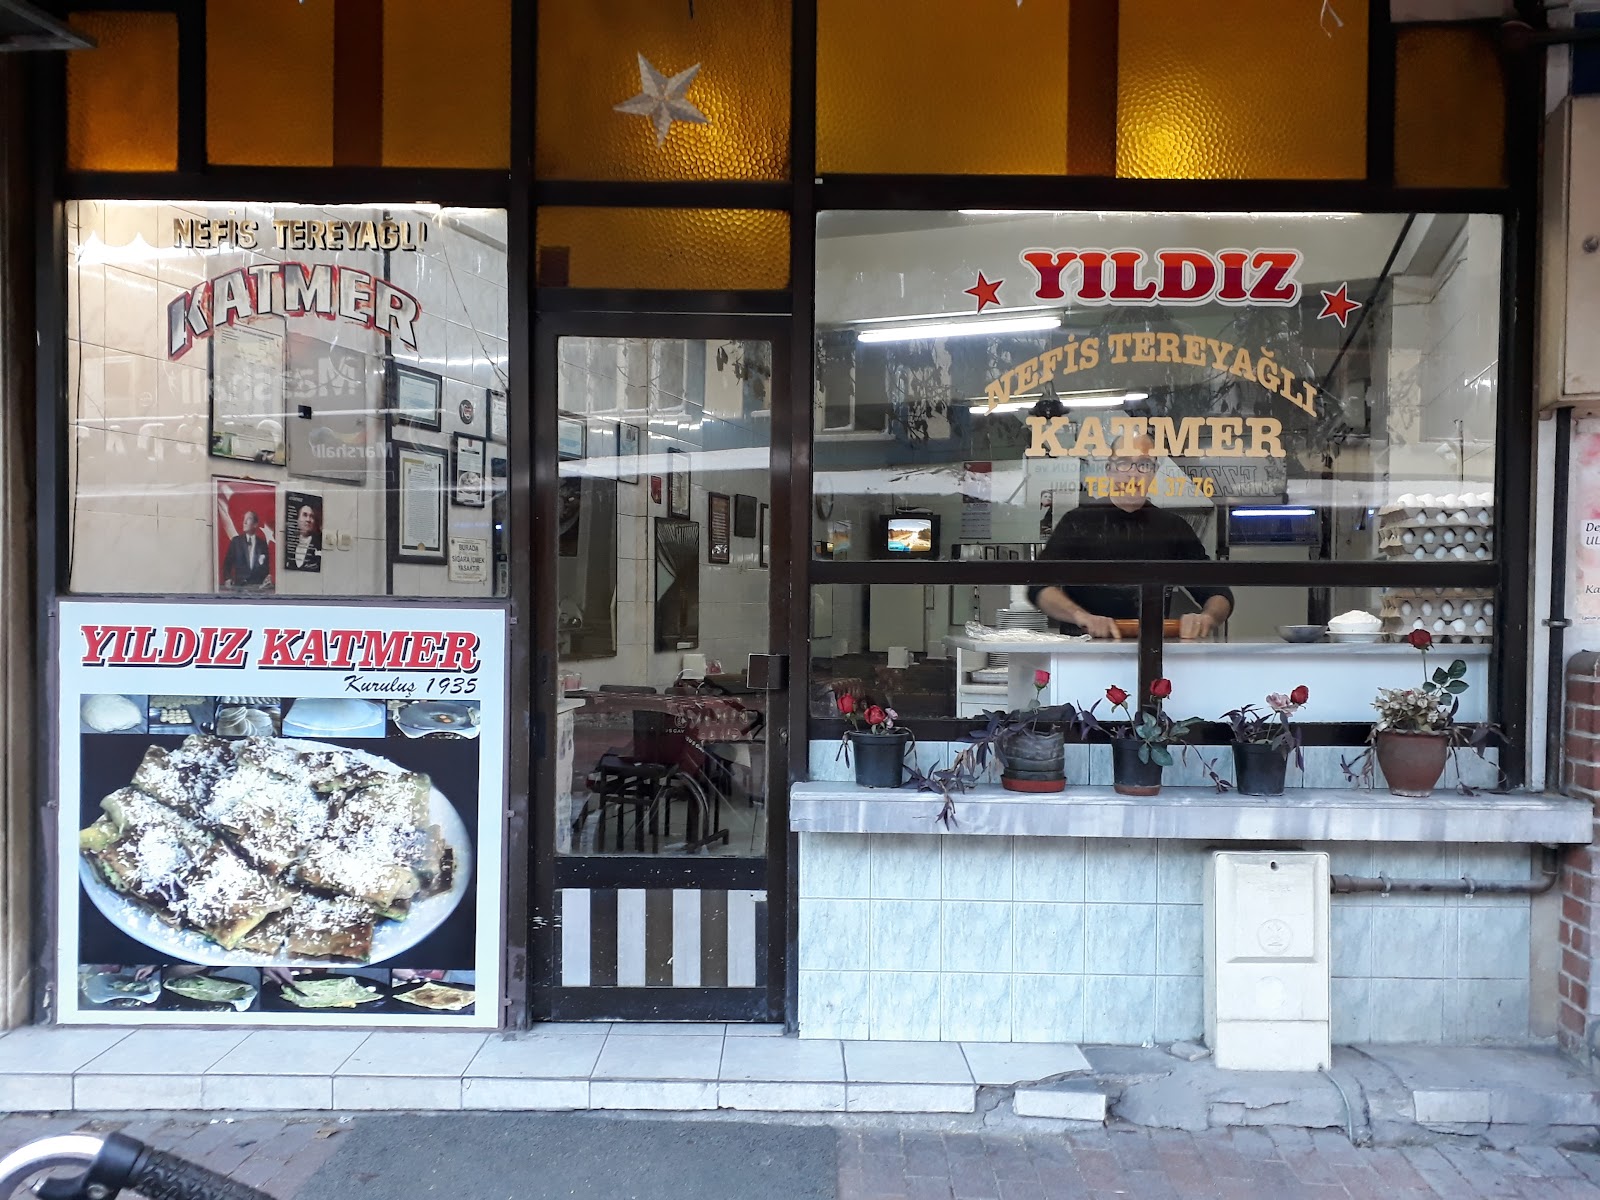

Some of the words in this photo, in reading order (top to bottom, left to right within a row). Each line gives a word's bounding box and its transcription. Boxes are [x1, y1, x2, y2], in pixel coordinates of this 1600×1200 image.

[1019, 246, 1303, 307] YILDIZ
[167, 260, 423, 361] KATMER
[983, 333, 1100, 417] NEFİS
[1107, 331, 1319, 418] TEREYAĞLI
[1024, 416, 1287, 458] KATMER
[1084, 476, 1159, 498] TEL:414
[1165, 476, 1188, 497] 37
[1192, 476, 1216, 498] 76
[80, 623, 254, 670] YILDIZ
[257, 627, 482, 674] KATMER
[343, 675, 417, 697] Kuruluş
[425, 676, 479, 694] 1935
